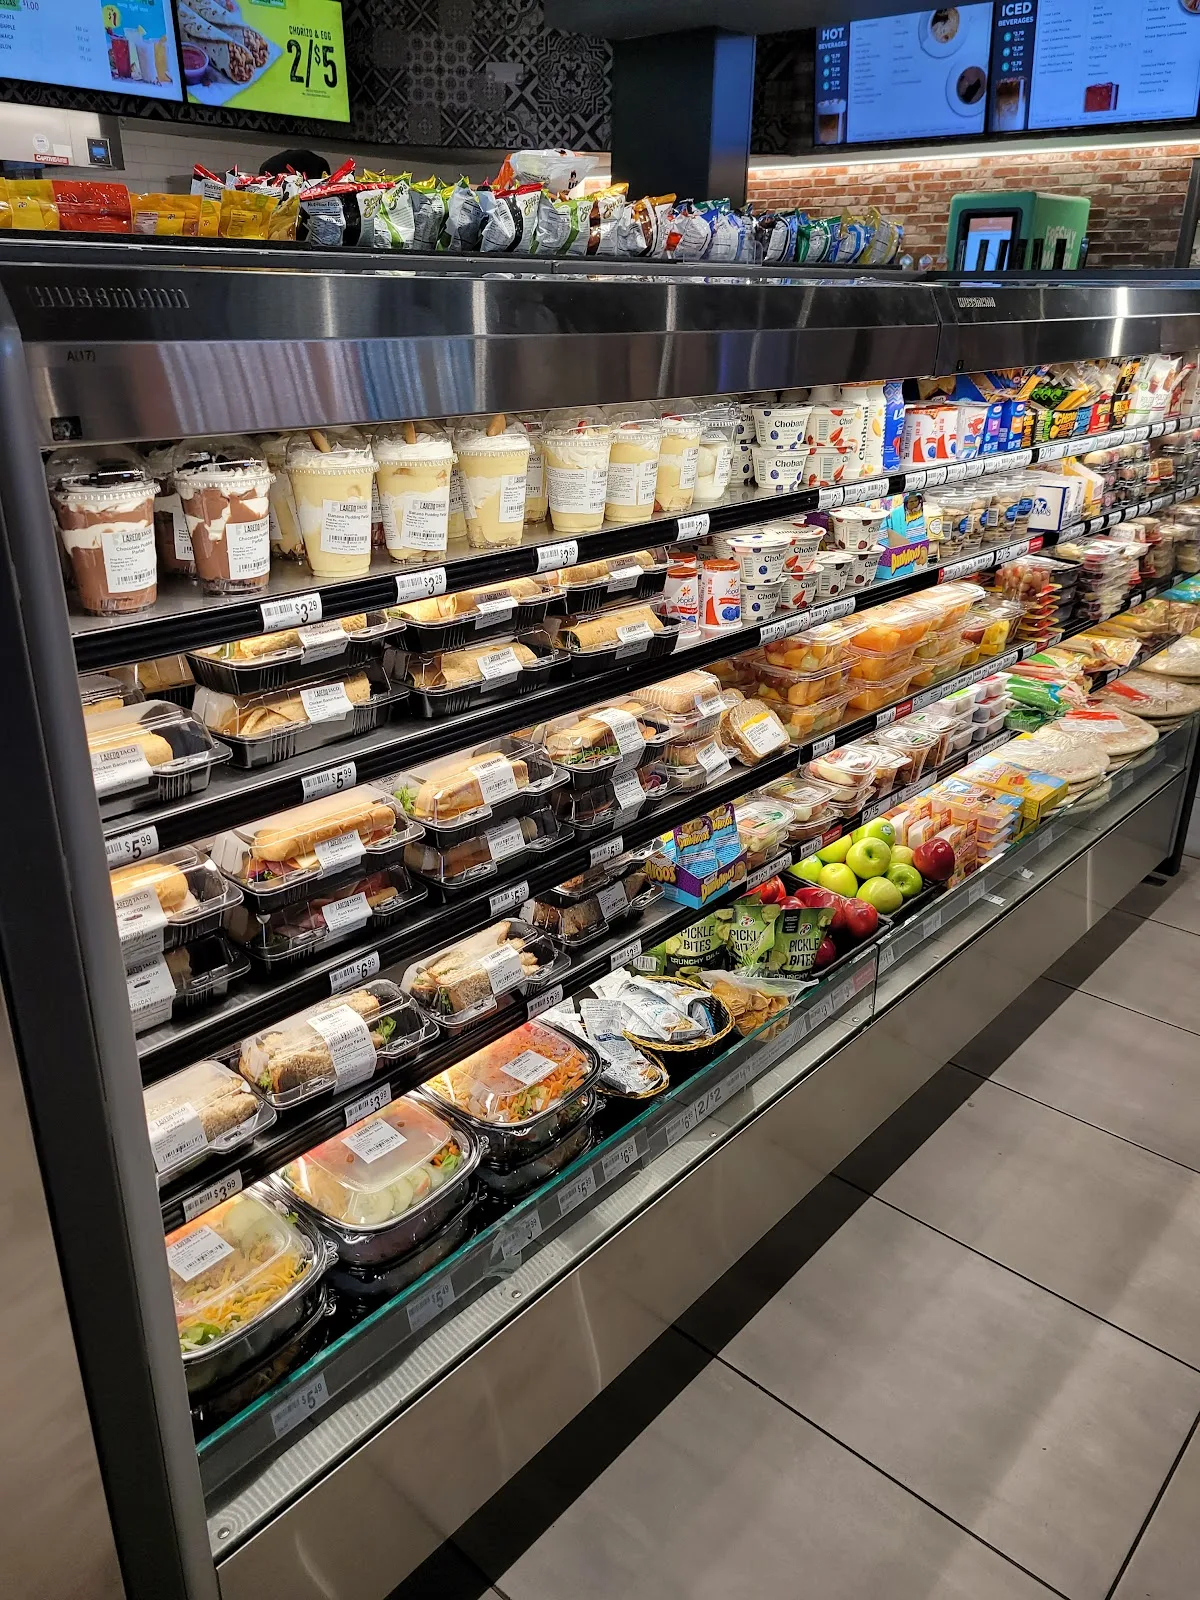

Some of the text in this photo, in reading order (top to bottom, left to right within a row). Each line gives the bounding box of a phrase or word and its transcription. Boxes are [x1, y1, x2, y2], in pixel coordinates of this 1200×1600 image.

[1002, 2, 1032, 16] ICED
[998, 16, 1034, 26] BEVERAGES
[289, 26, 332, 40] CHORIZO & EGG
[822, 27, 844, 40] HOT
[818, 41, 847, 50] BEVERAGES
[286, 39, 338, 88] 2/$5
[67, 350, 95, 362] A(17)
[858, 406, 869, 461] Chobani
[120, 748, 136, 756] TACO
[681, 925, 714, 953] PICKLE BITES
[789, 938, 819, 952] PICKLE
[142, 960, 157, 969] TACO
[671, 956, 703, 966] CRUNCHY
[789, 953, 816, 966] BITES
